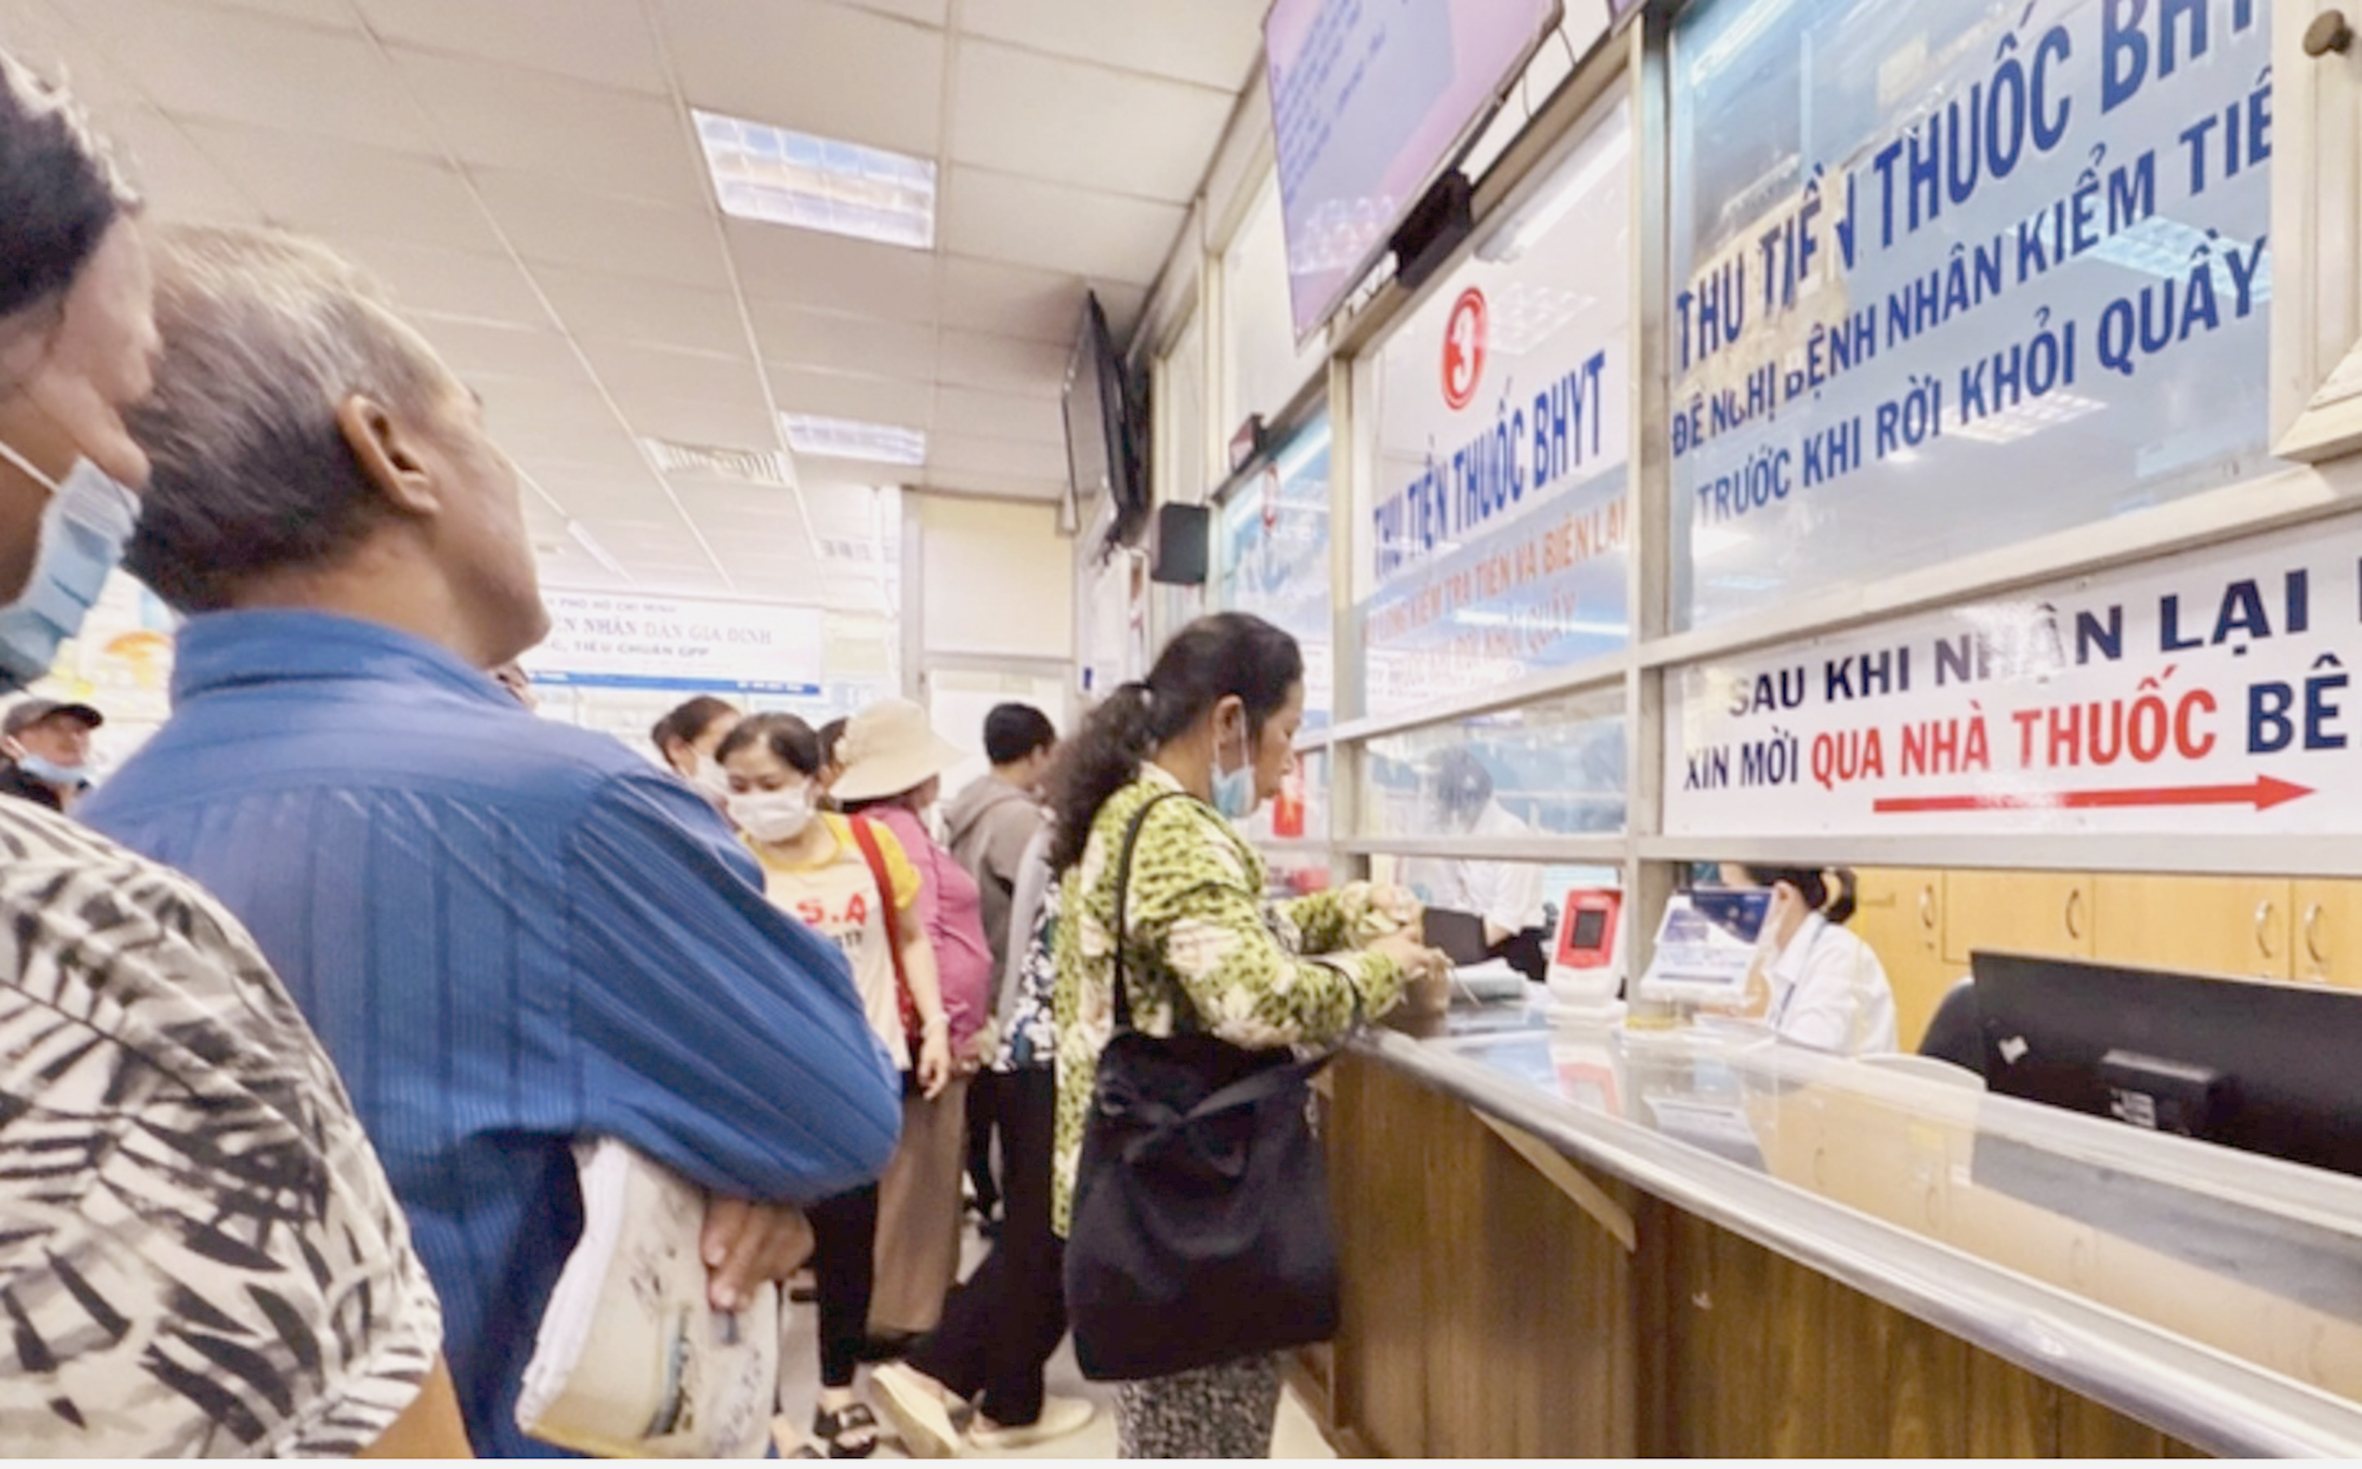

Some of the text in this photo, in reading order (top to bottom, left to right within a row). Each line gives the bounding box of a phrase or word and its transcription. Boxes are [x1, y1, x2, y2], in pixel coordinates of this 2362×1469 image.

[1676, 250, 1744, 372] THU
[1873, 0, 2071, 249] THUỐC
[1886, 233, 2002, 348] NHÂN
[2016, 142, 2155, 285] KIỂM
[1454, 376, 1525, 535] THUỐC
[1534, 349, 1606, 491] BHYT
[1697, 228, 2267, 527] TRƯỚC KHI RỜI KHỎI QUẦY
[1684, 745, 1730, 791] XIN
[1740, 725, 1799, 787] MỜI
[1811, 727, 1886, 792] QUA
[1901, 700, 1991, 777] NHÀ
[2012, 664, 2218, 769] THUỐC
[1728, 666, 1805, 718] SAU
[1824, 646, 1910, 703] KHI
[2160, 567, 2308, 657] LẠI
